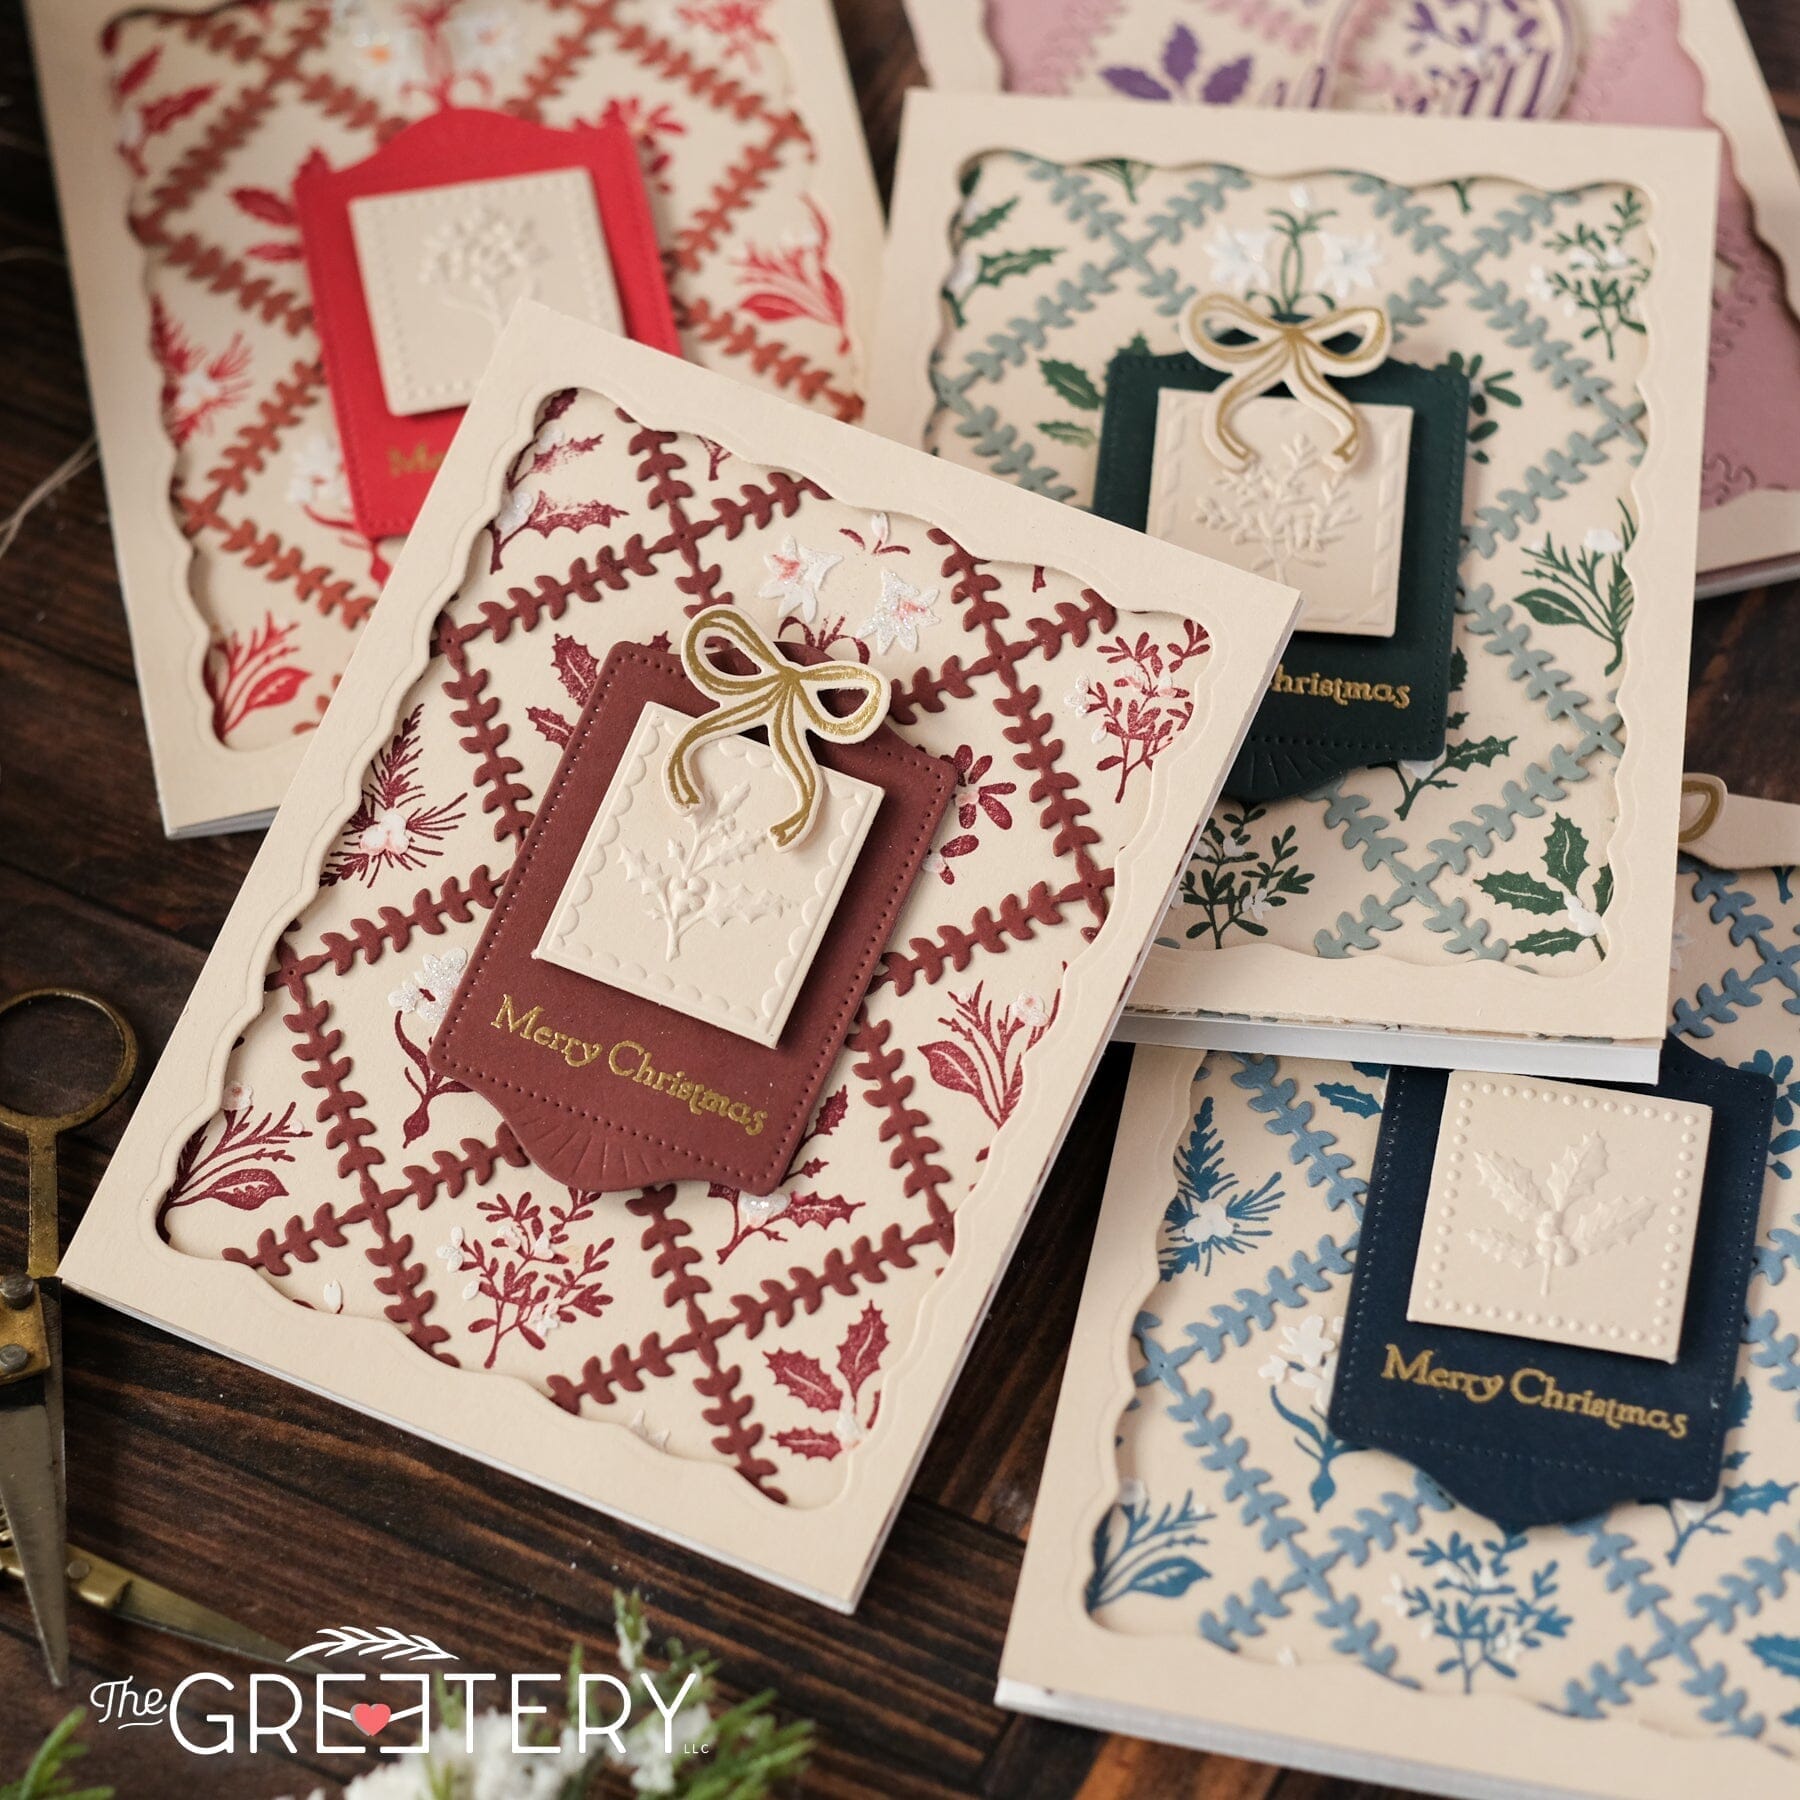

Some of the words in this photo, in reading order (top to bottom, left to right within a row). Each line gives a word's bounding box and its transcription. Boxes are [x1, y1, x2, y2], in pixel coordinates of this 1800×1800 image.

[1270, 663, 1410, 709] hristmas
[490, 994, 602, 1068] Merry
[607, 1039, 769, 1136] Christmas
[1380, 1343, 1504, 1404] Merry
[1510, 1367, 1688, 1439] Christmas
